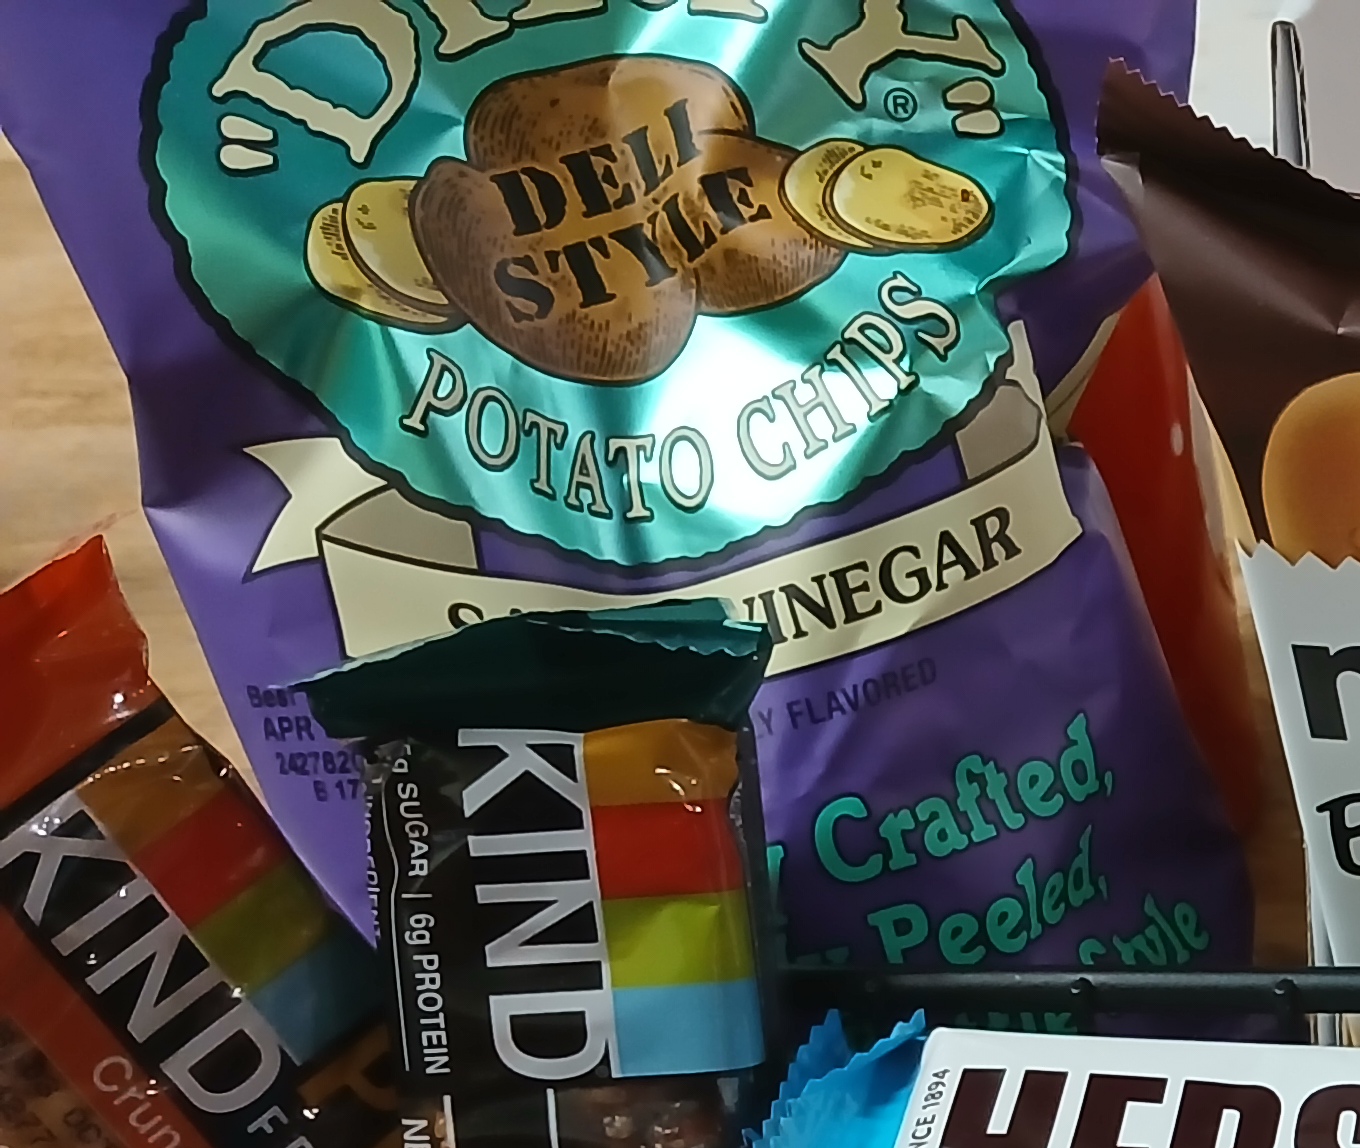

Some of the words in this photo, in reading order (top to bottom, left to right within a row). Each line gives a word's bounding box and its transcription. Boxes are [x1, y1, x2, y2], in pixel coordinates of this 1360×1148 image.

[492, 98, 705, 238] DELI
[492, 166, 773, 324] STYLE
[401, 350, 714, 522] POTATO
[735, 272, 962, 482] CHIPS
[263, 716, 315, 741] APR
[786, 656, 938, 730] FLAVORED
[397, 781, 429, 877] SUGAR
[814, 712, 1115, 884] Crafted,
[0, 791, 283, 1114] KIND
[404, 913, 435, 946] 6g
[458, 728, 612, 1081] KIND
[868, 823, 1108, 966] Peeled,
[412, 953, 451, 1075] PROTEIN
[921, 1067, 951, 1112] 1894
